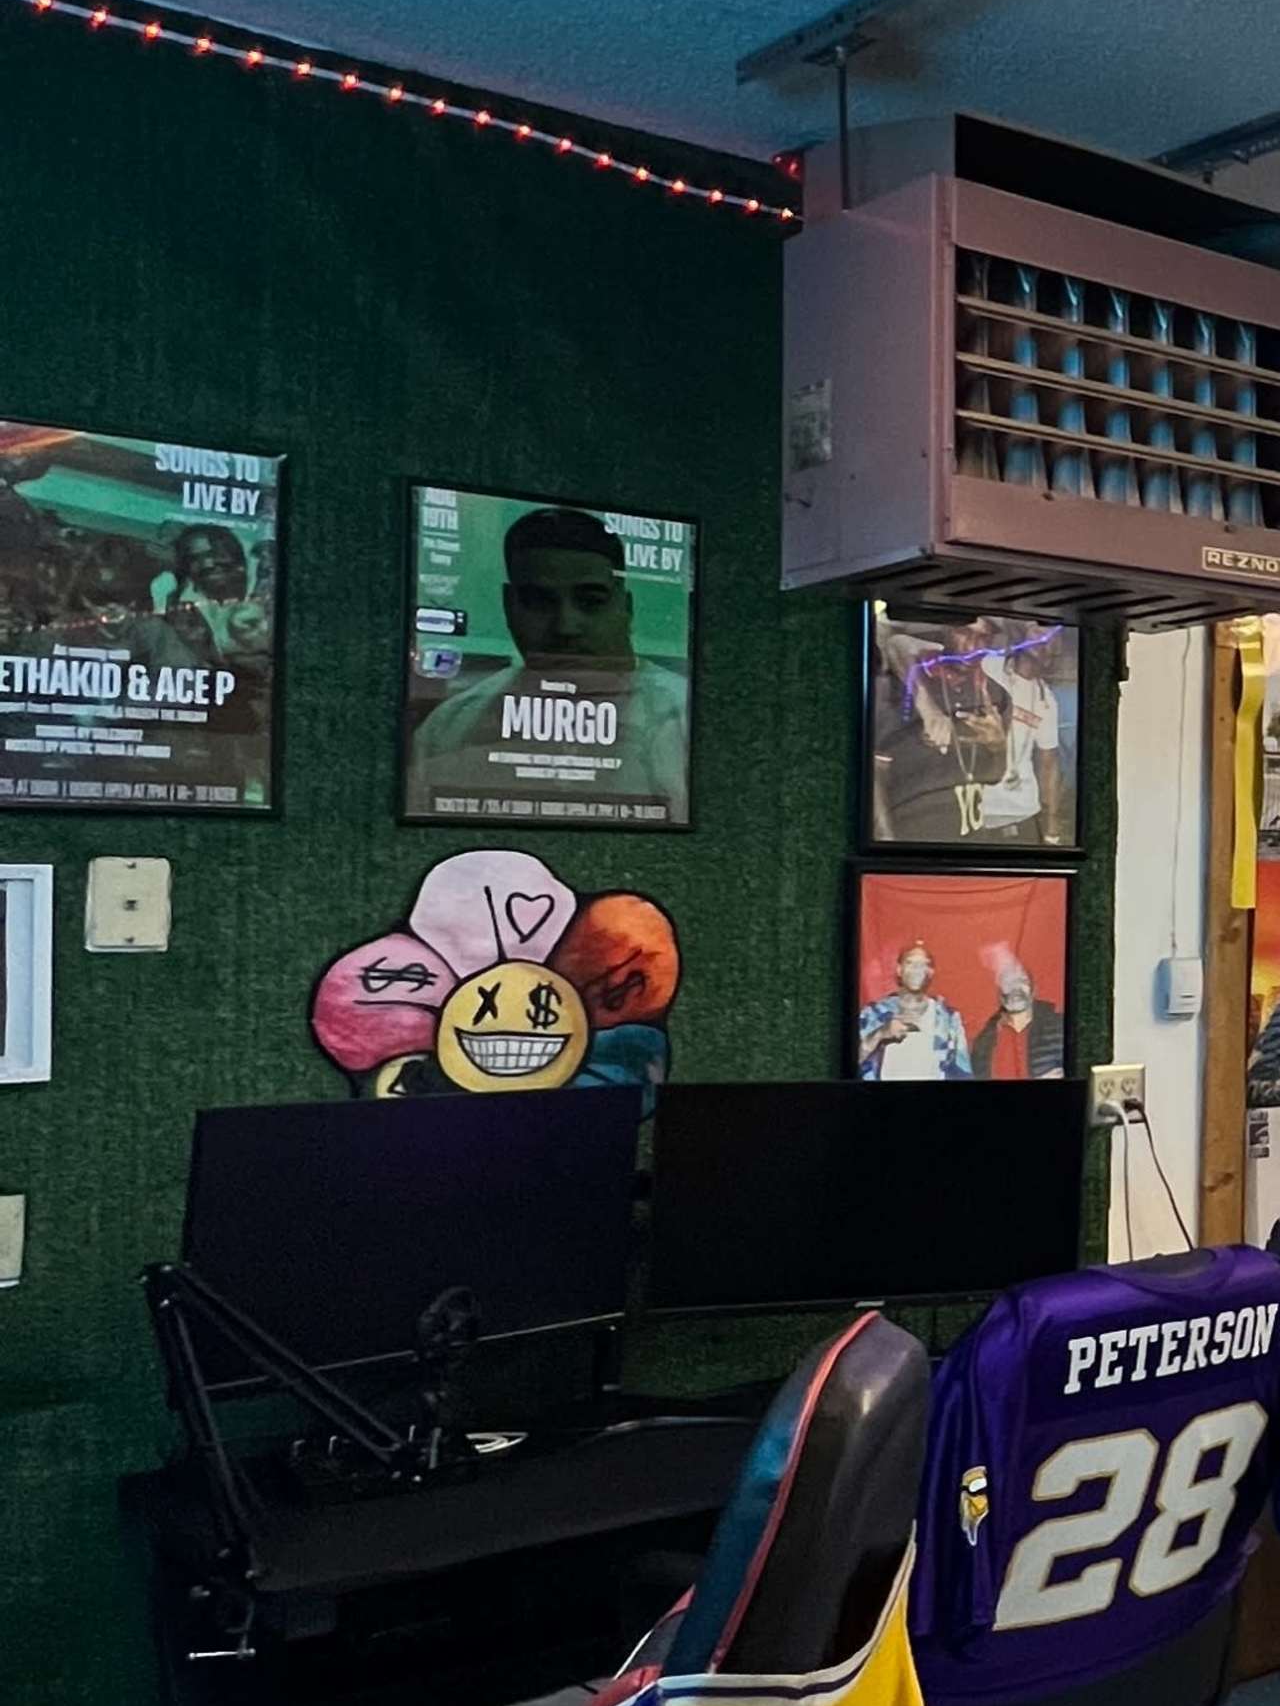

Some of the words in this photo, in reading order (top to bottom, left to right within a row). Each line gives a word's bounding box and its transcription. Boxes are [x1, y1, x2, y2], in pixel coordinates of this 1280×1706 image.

[155, 444, 229, 479] SONGS
[233, 454, 260, 483] TO
[182, 481, 227, 513] LIVE
[231, 487, 260, 515] BY
[625, 543, 658, 569] LIVE
[662, 548, 683, 572] BY
[127, 664, 151, 701] &
[155, 666, 210, 705] ACE
[214, 670, 236, 706] P
[501, 695, 617, 746] MURGO
[1064, 1303, 1279, 1394] PETERSON
[992, 1400, 1269, 1632] 28
